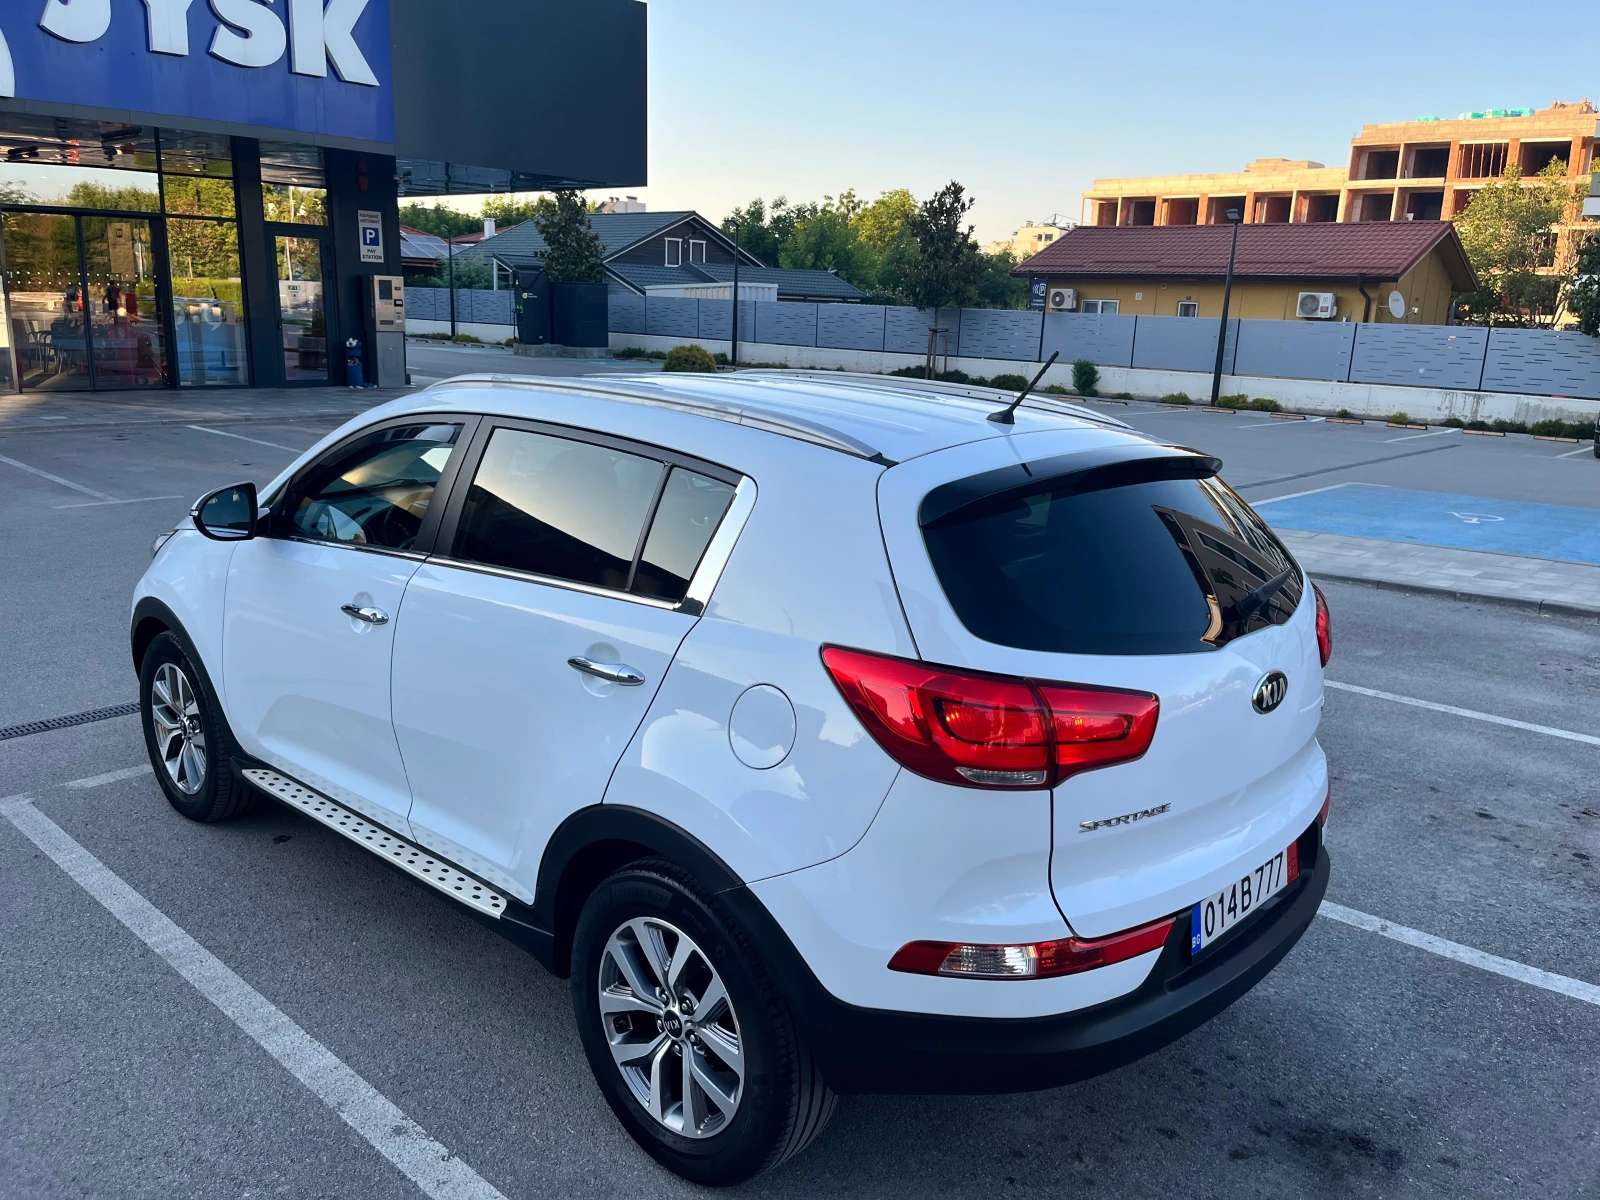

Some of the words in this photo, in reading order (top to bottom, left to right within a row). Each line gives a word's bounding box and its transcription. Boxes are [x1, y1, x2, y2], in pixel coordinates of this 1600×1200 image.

[366, 229, 376, 243] P
[1261, 677, 1286, 708] KIA
[1079, 802, 1172, 833] SPORTAGE
[1204, 850, 1284, 938] 014B777
[1191, 933, 1201, 949] BG
[664, 1019, 681, 1030] KIA
